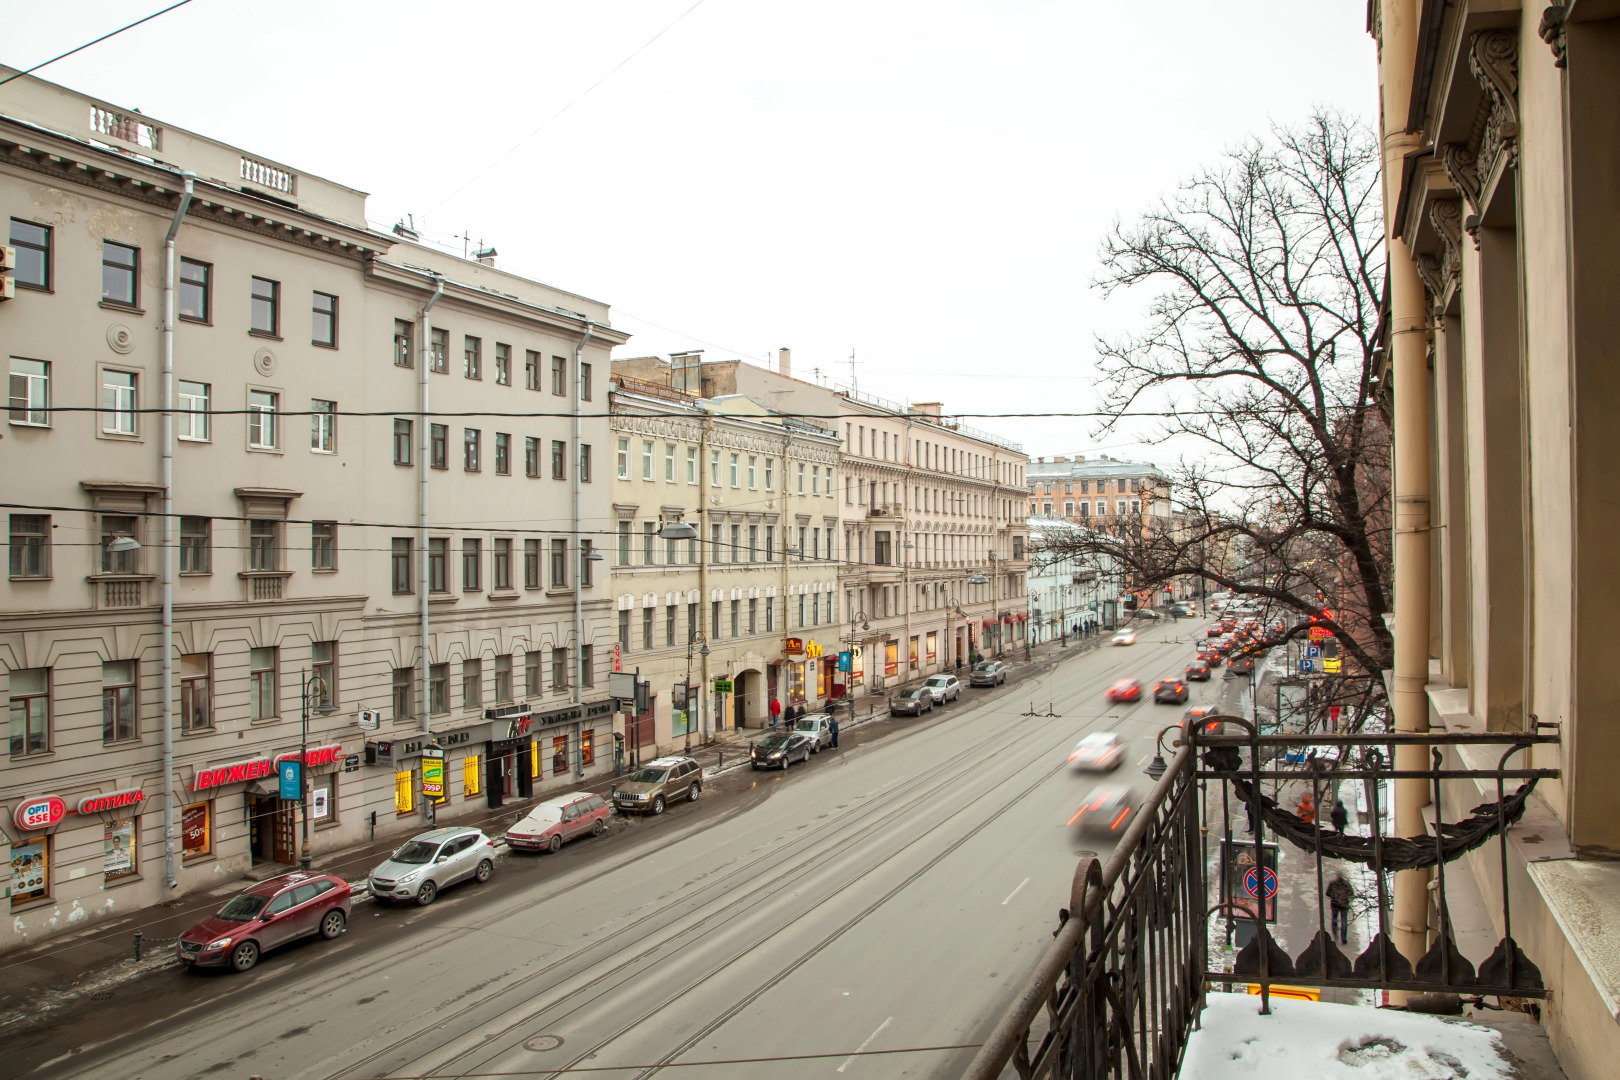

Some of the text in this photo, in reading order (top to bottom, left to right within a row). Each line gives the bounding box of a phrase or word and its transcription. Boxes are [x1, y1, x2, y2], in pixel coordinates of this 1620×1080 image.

[1310, 647, 1317, 657] P
[199, 759, 270, 790] ВИЖЕН
[83, 789, 144, 814] ОПТИКА
[27, 804, 48, 815] OPTI
[28, 813, 48, 825] SSE
